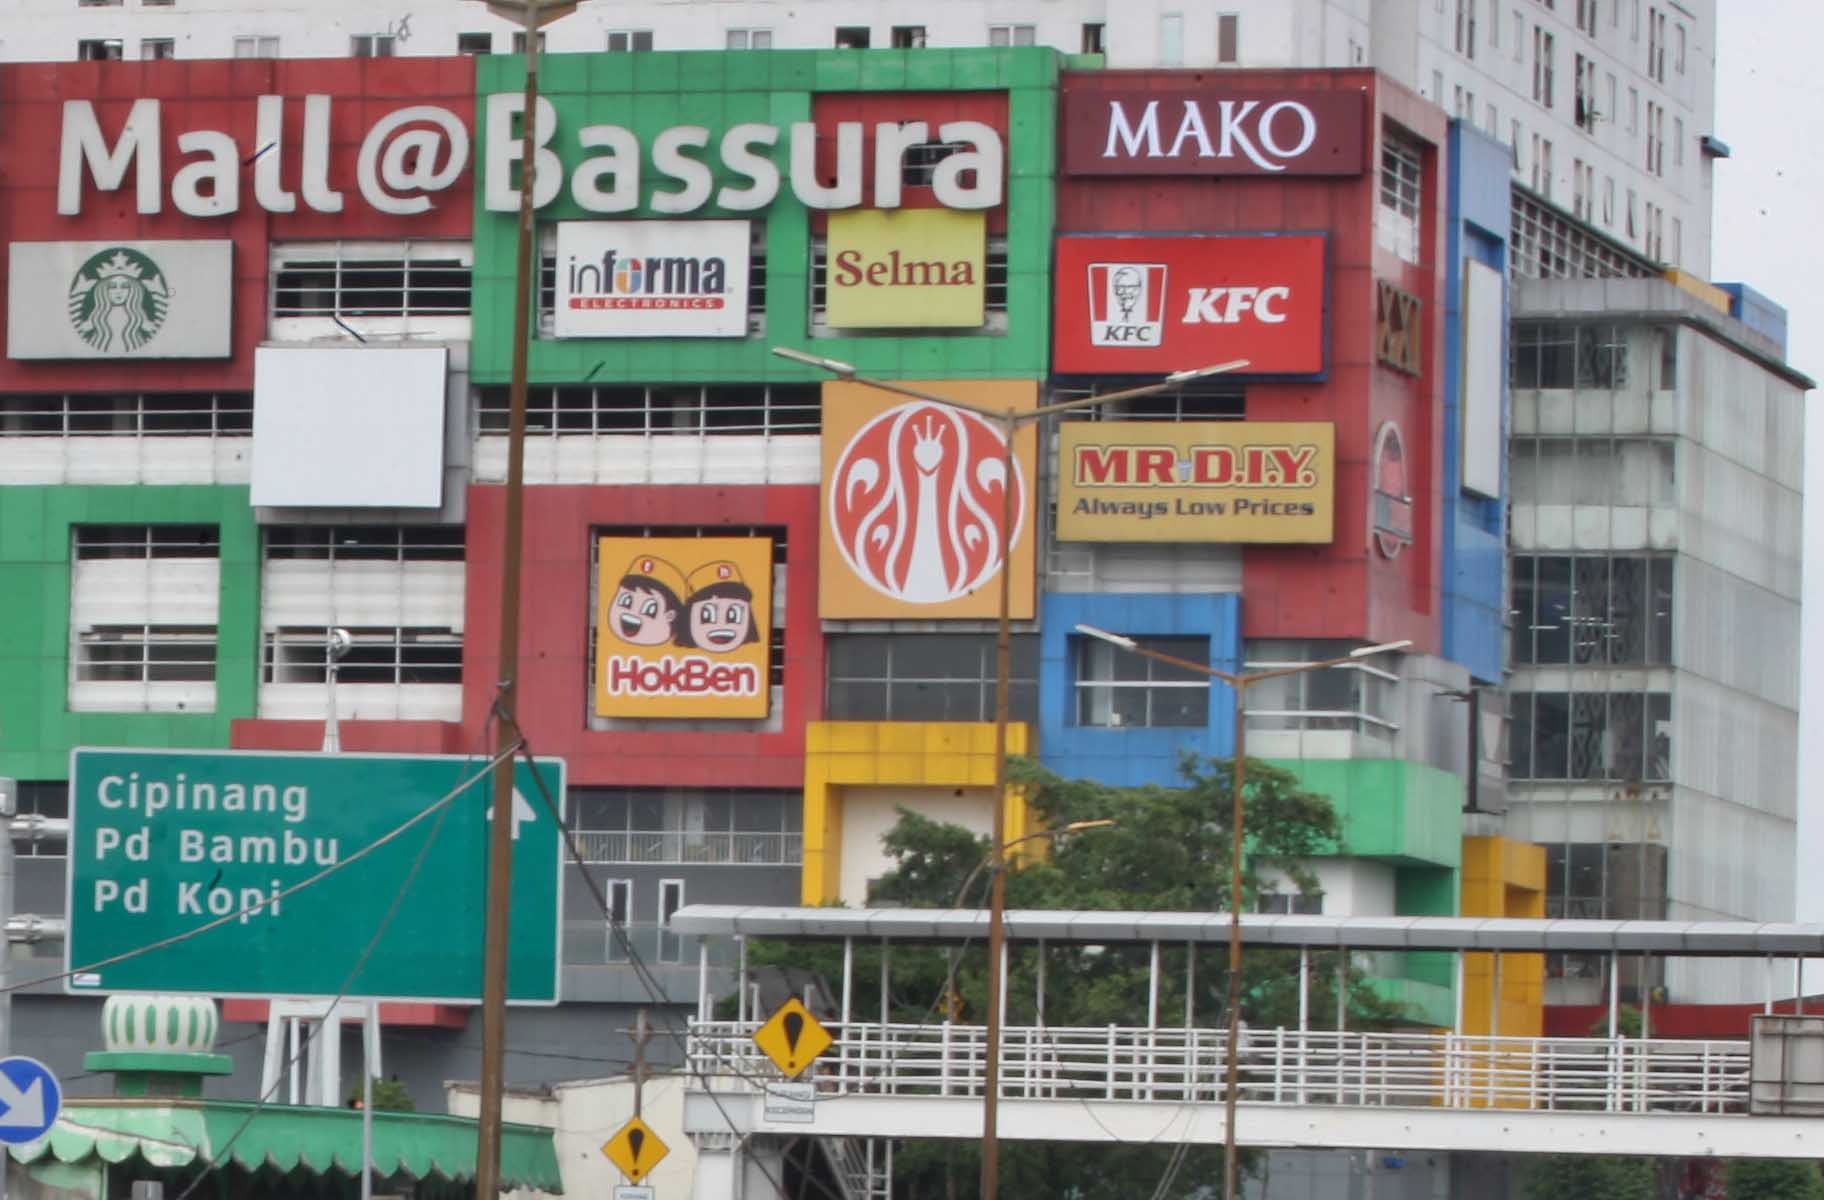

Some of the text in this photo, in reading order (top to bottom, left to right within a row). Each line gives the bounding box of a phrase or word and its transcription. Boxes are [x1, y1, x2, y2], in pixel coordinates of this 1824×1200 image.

[1103, 100, 1317, 171] MAKO
[568, 249, 726, 295] informa
[835, 249, 975, 288] Selma
[580, 298, 717, 309] ELECTRONICS
[1181, 286, 1290, 324] KFC
[1103, 325, 1153, 342] KFC
[1076, 447, 1176, 486] MR
[1074, 497, 1315, 519] Always Low Prices
[610, 657, 756, 694] HokBen
[97, 773, 309, 823] Cipinang
[95, 826, 339, 865] Pd Bambu
[94, 879, 283, 925] Pd Kopi
